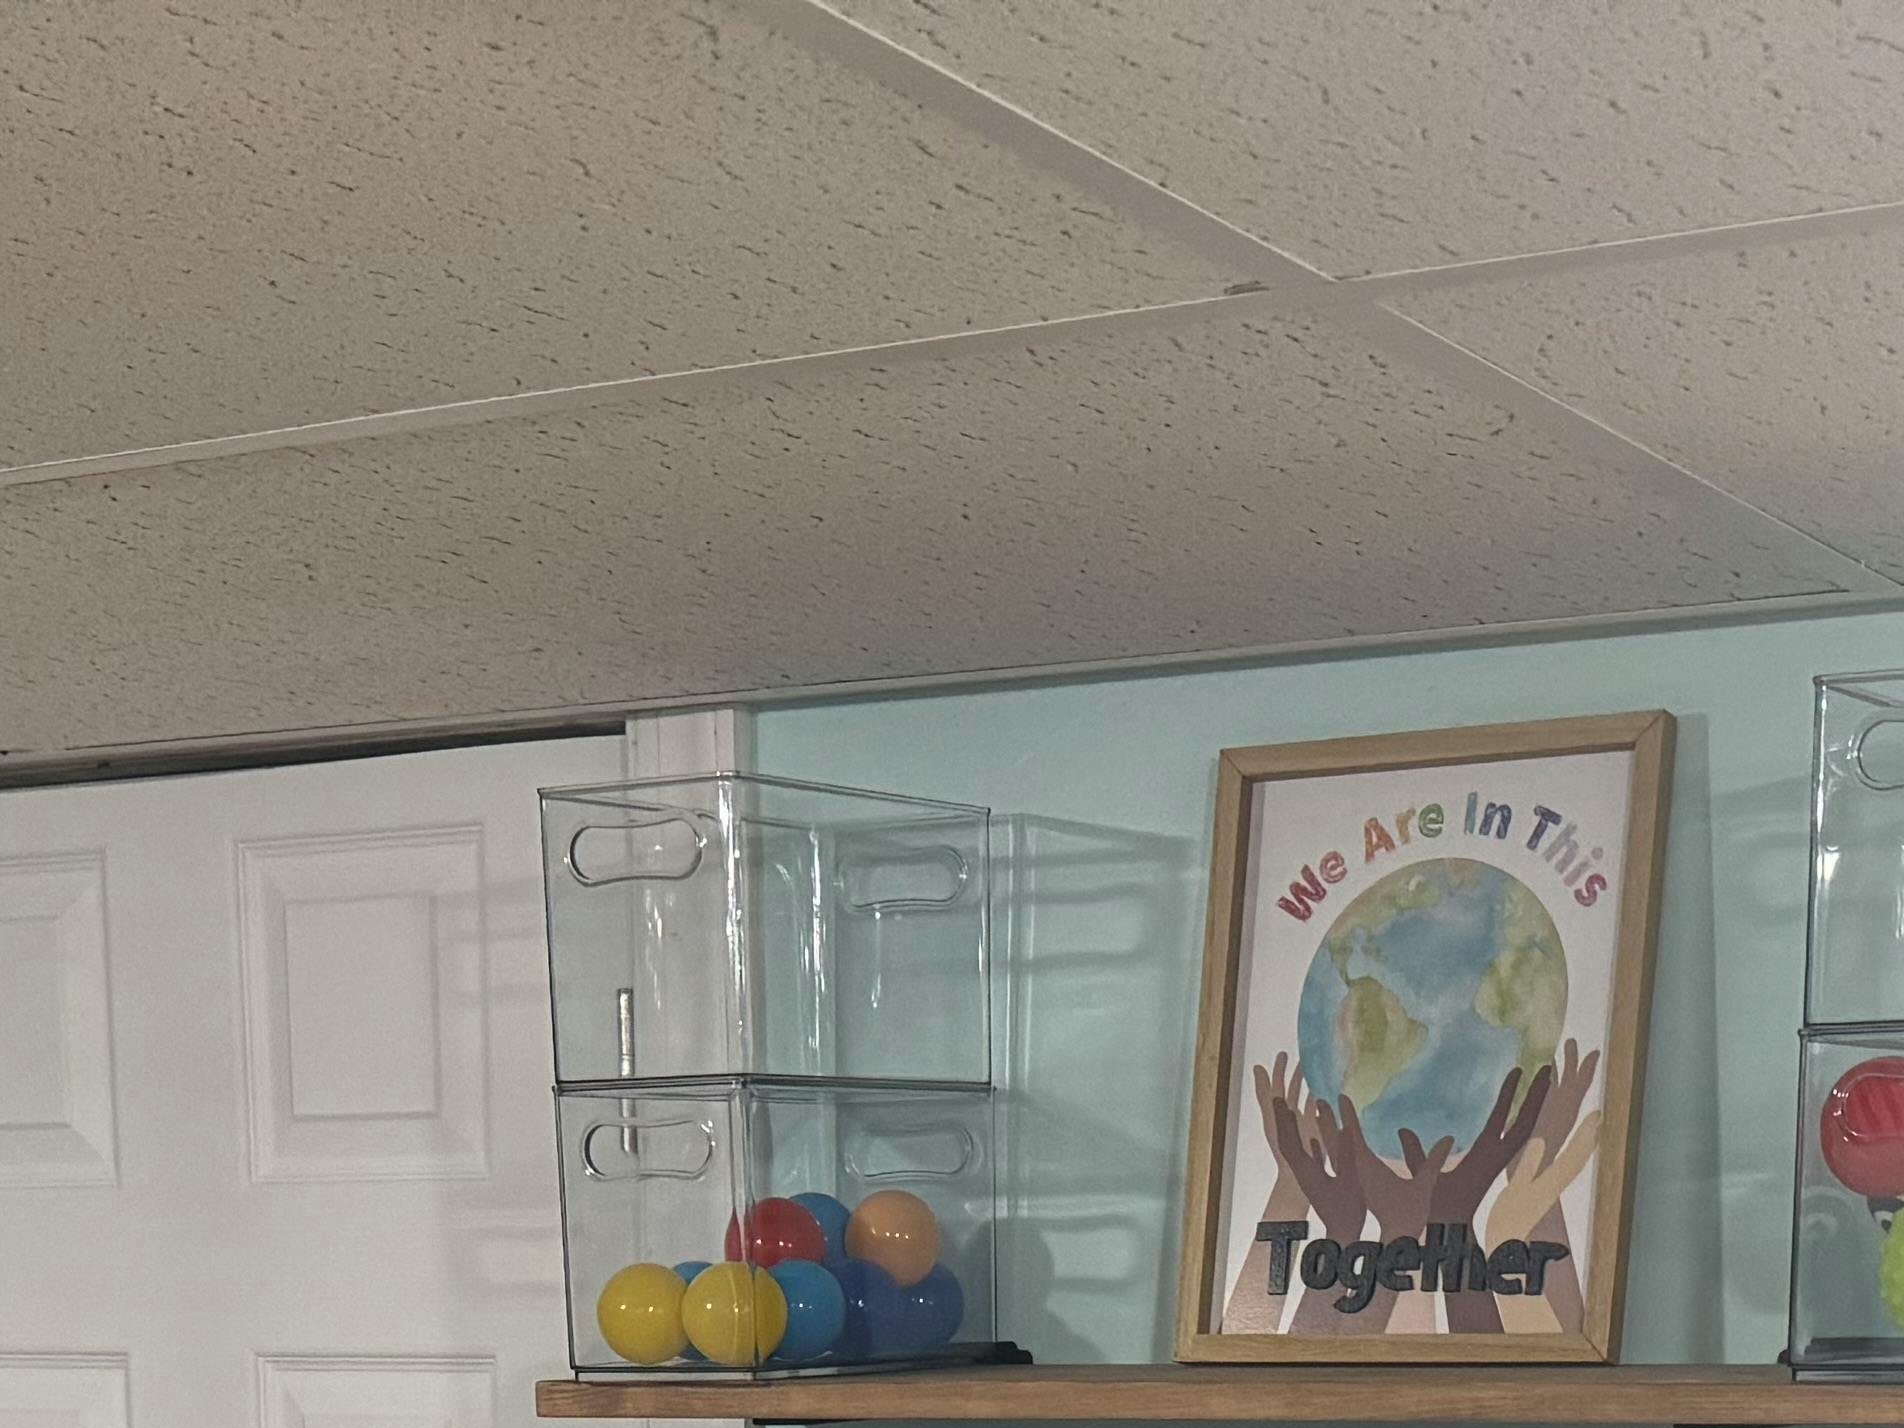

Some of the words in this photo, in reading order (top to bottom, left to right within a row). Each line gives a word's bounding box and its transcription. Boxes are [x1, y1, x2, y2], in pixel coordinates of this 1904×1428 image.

[1277, 850, 1347, 921] We
[1364, 803, 1444, 863] Are
[1464, 791, 1512, 839] In
[1526, 805, 1607, 906] This
[1256, 1221, 1570, 1313] Together
